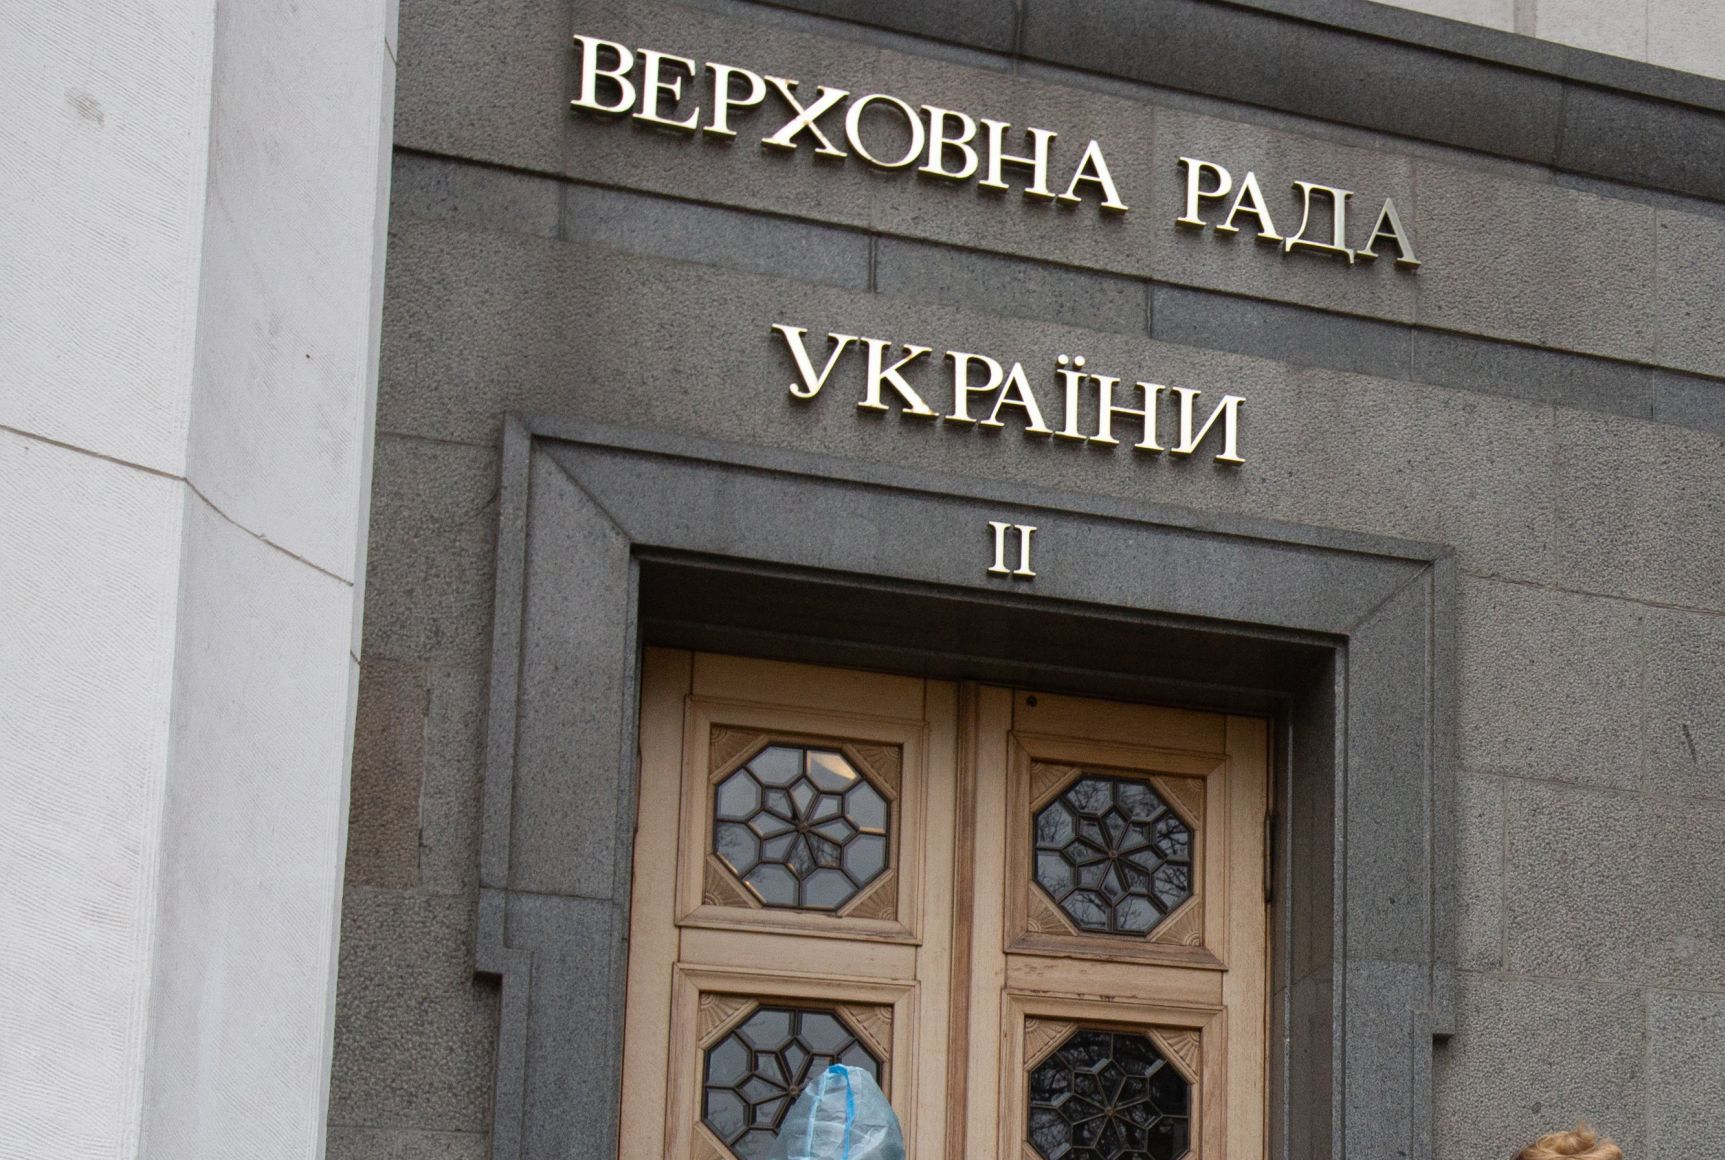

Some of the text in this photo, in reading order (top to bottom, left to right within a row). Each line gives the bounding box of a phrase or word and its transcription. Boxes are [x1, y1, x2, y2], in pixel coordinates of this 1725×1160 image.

[571, 34, 1422, 270] ВЕРХОВНА РАДА
[770, 323, 1247, 466] УКРАЇНИ
